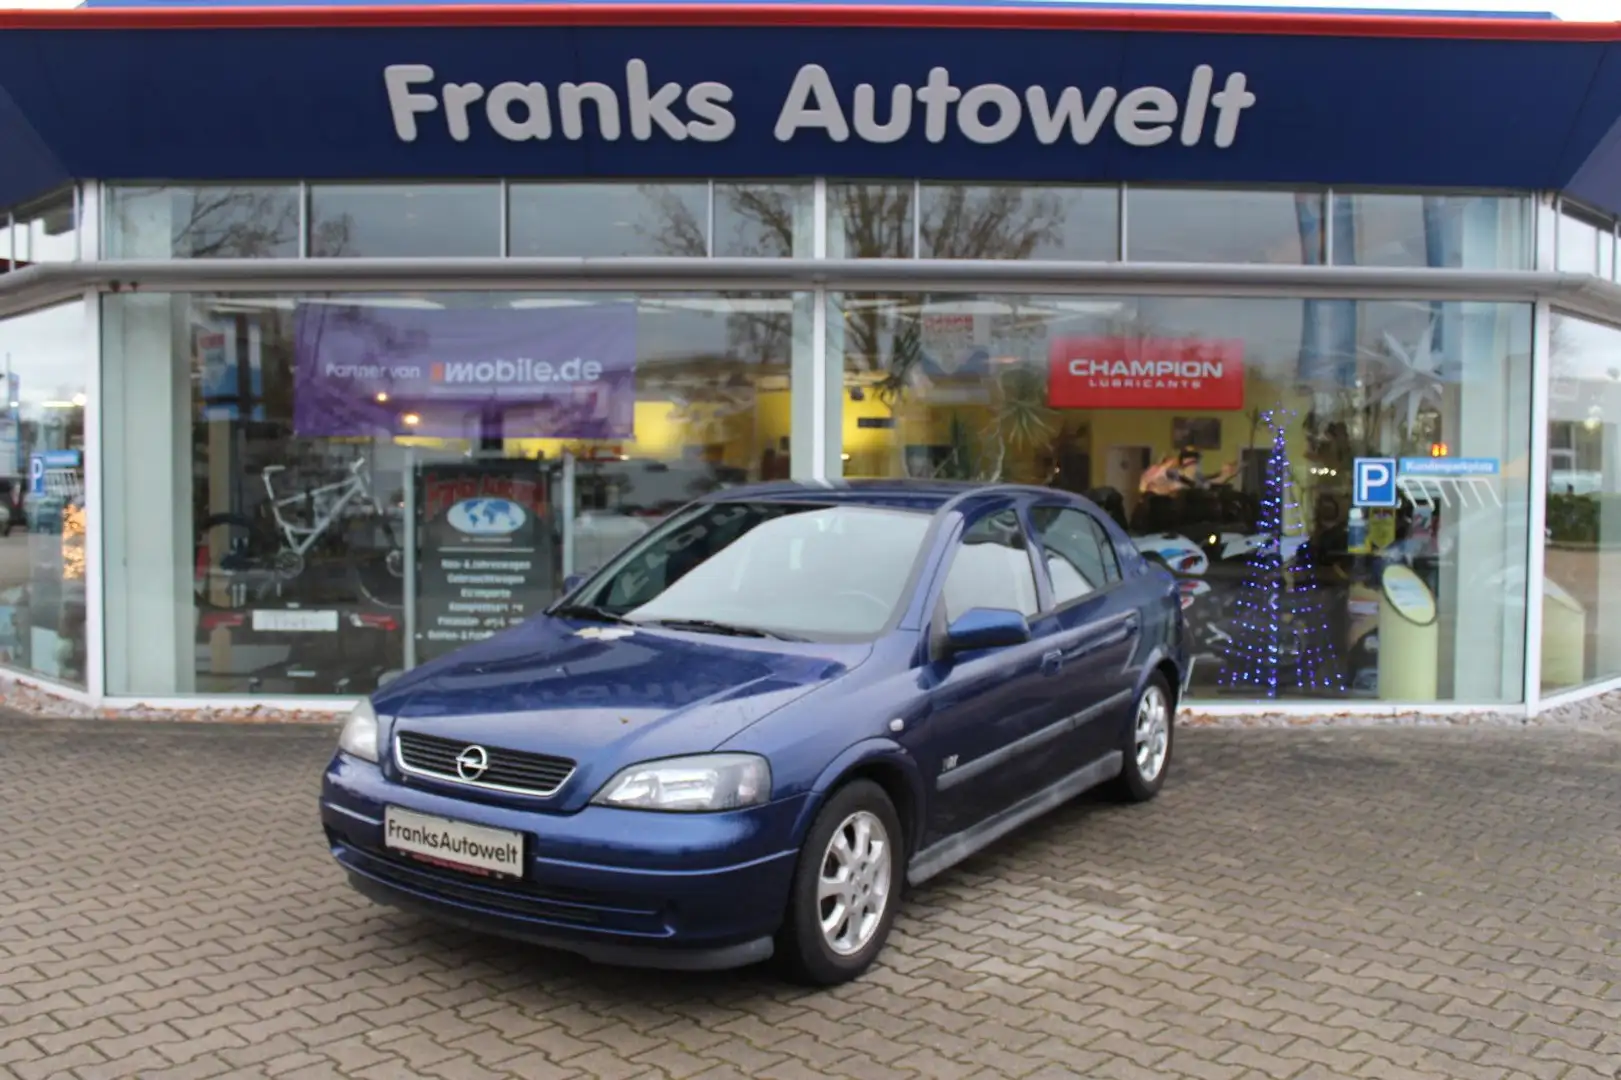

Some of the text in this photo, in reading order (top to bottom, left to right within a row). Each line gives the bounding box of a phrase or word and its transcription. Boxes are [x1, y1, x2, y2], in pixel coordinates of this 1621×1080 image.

[384, 58, 1256, 148] Franks Autowelt
[325, 363, 387, 379] Partner
[430, 357, 602, 382] mobile.de
[1068, 358, 1223, 378] CHAMPION
[1089, 379, 1202, 389] LUBRICANTS
[1360, 463, 1389, 500] P
[388, 819, 518, 865] FranksAutowelt
